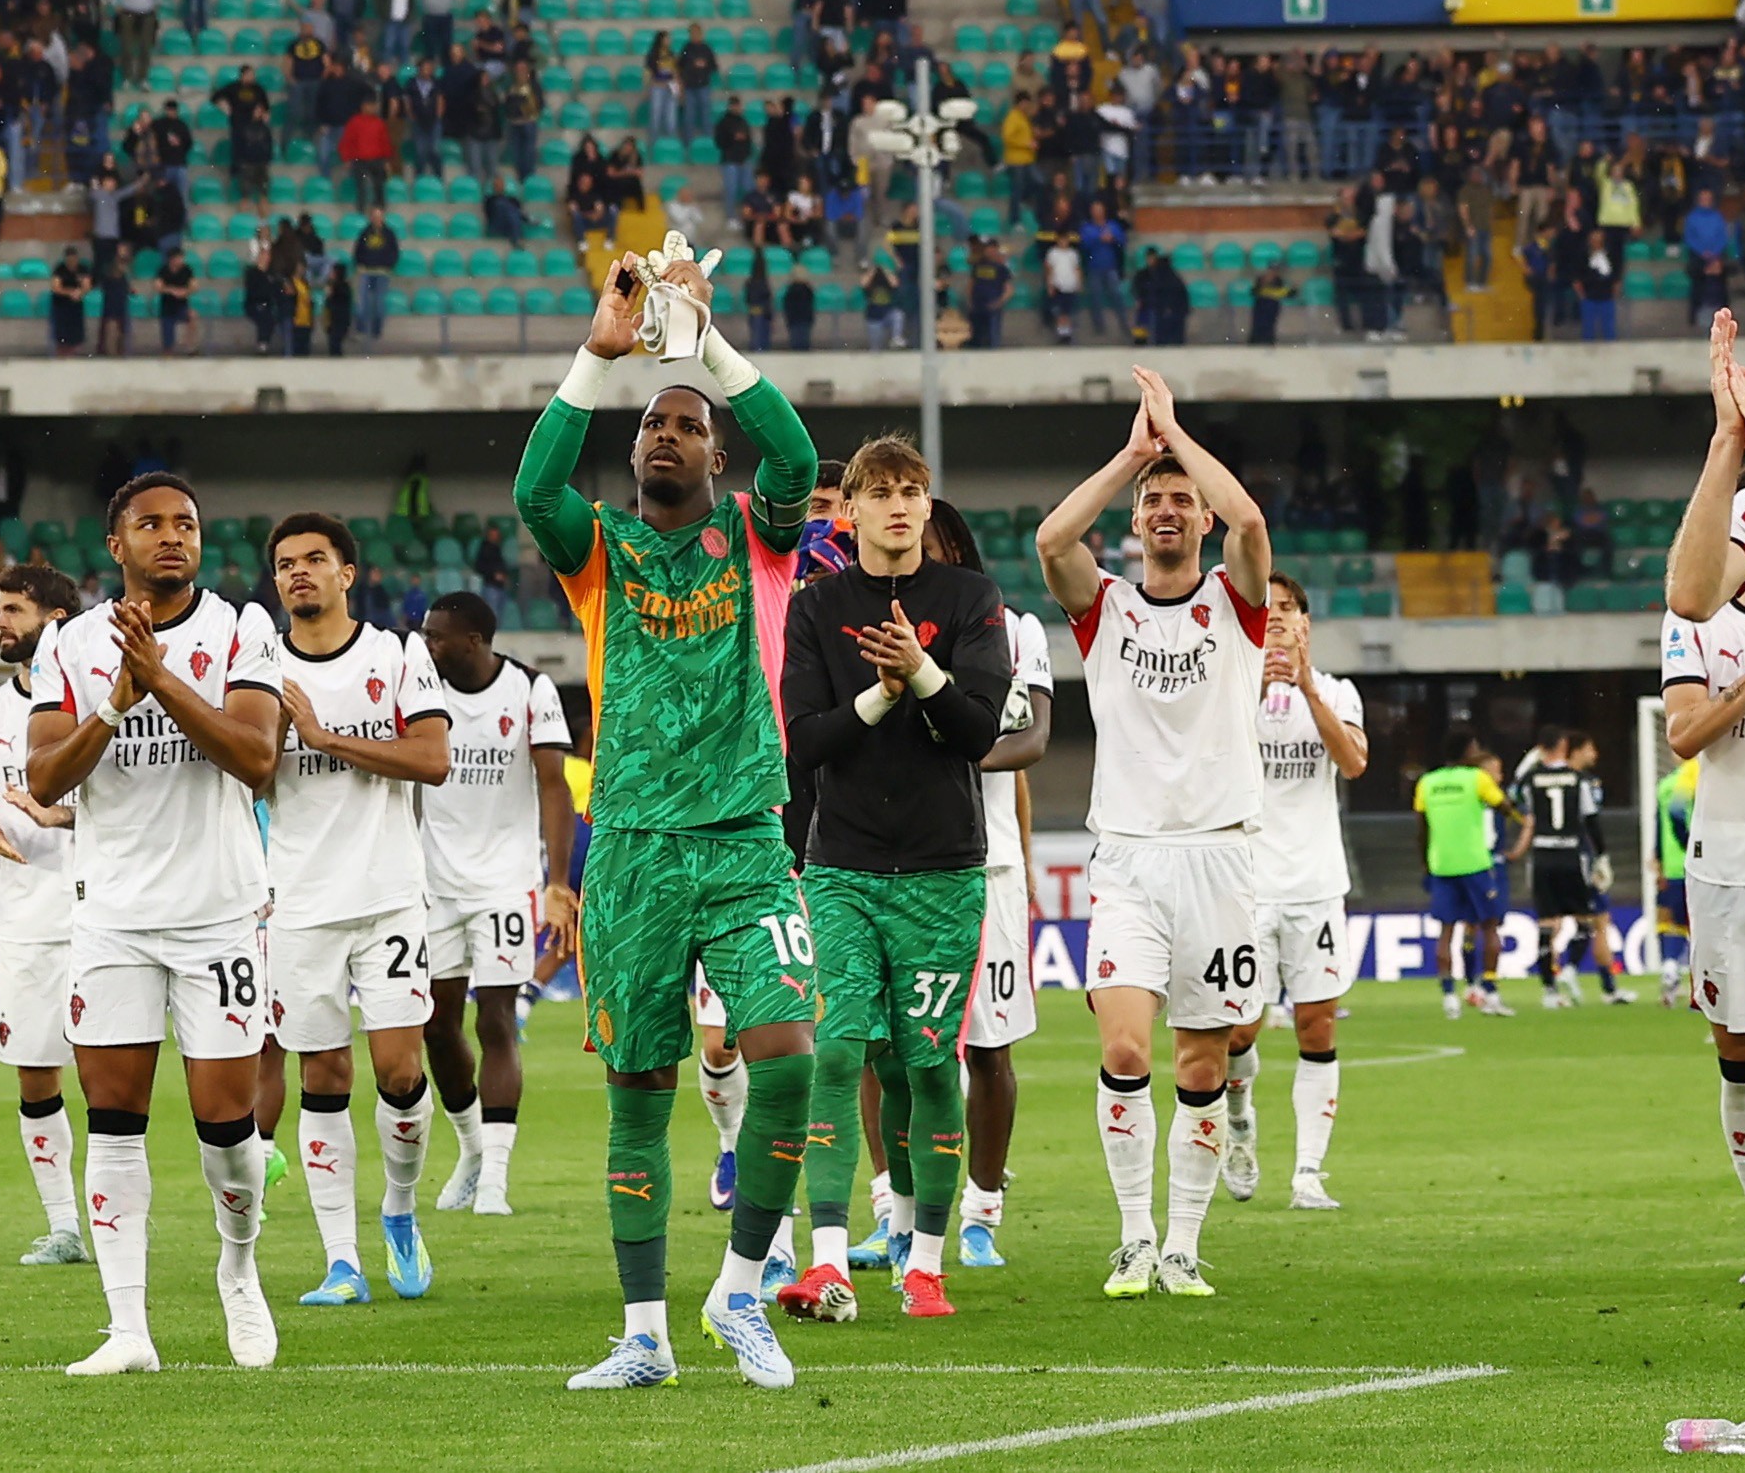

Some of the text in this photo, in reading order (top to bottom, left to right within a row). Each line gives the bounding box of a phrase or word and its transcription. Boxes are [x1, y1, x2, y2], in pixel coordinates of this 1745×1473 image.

[1131, 669, 1156, 690] FLY
[115, 743, 143, 768] FLY
[298, 754, 323, 777] FLY
[1273, 761, 1317, 779] BETTER
[460, 768, 505, 786] BETTER
[1545, 787, 1565, 831] 1
[489, 912, 525, 948] 19
[759, 913, 814, 966] 16
[1316, 920, 1336, 956] 4
[384, 935, 429, 979] 24
[1204, 944, 1257, 992] 46
[208, 956, 256, 1008] 18
[907, 971, 961, 1019] 37
[987, 960, 1015, 1003] 10
